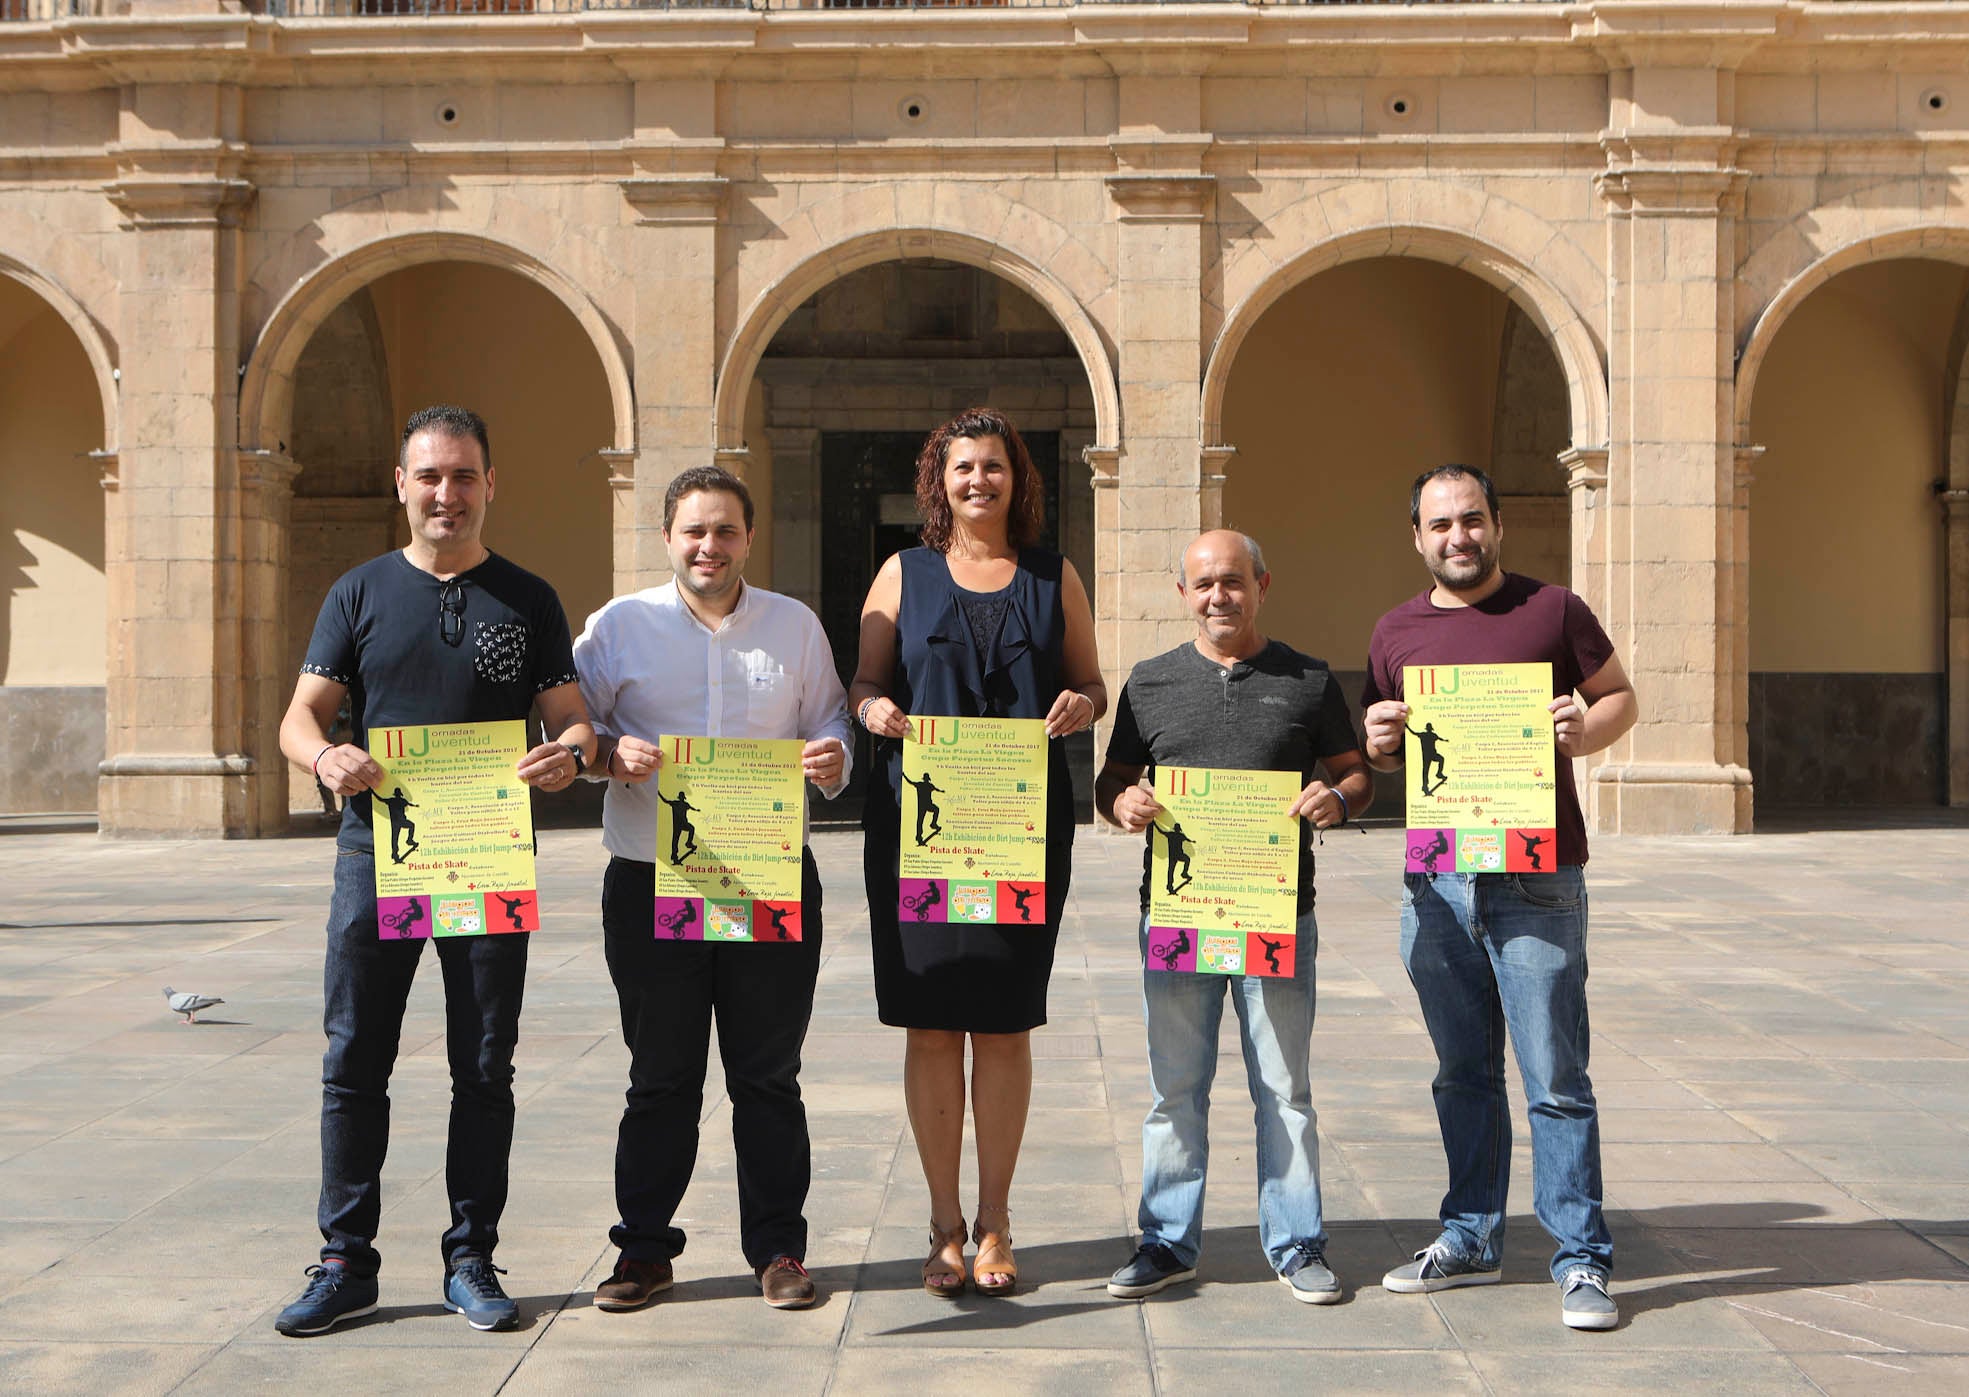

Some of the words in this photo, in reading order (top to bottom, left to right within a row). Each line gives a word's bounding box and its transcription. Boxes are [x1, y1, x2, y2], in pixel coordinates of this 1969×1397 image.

[918, 719, 937, 745] II
[384, 731, 406, 759] II
[673, 738, 693, 764] II
[470, 755, 502, 763] Virgen
[390, 768, 421, 776] Grupo
[424, 765, 470, 774] Perpetuo
[1169, 770, 1189, 796] II
[988, 833, 996, 842] de
[1009, 834, 1026, 845] Jump
[470, 844, 479, 854] de
[480, 844, 492, 853] Dirt
[493, 843, 511, 854] Jump
[744, 853, 751, 861] de
[752, 854, 764, 862] Dirt
[765, 854, 782, 864] Jump
[409, 862, 430, 871] Pista
[432, 861, 443, 869] de
[444, 859, 468, 868] Skate
[708, 865, 718, 873] de
[719, 866, 741, 874] Skate
[1239, 884, 1247, 893] de
[1248, 885, 1259, 893] Dirt
[1260, 886, 1277, 897] Jump
[1181, 896, 1201, 904] Pista
[1203, 896, 1213, 904] de
[1214, 897, 1236, 905] Skate
